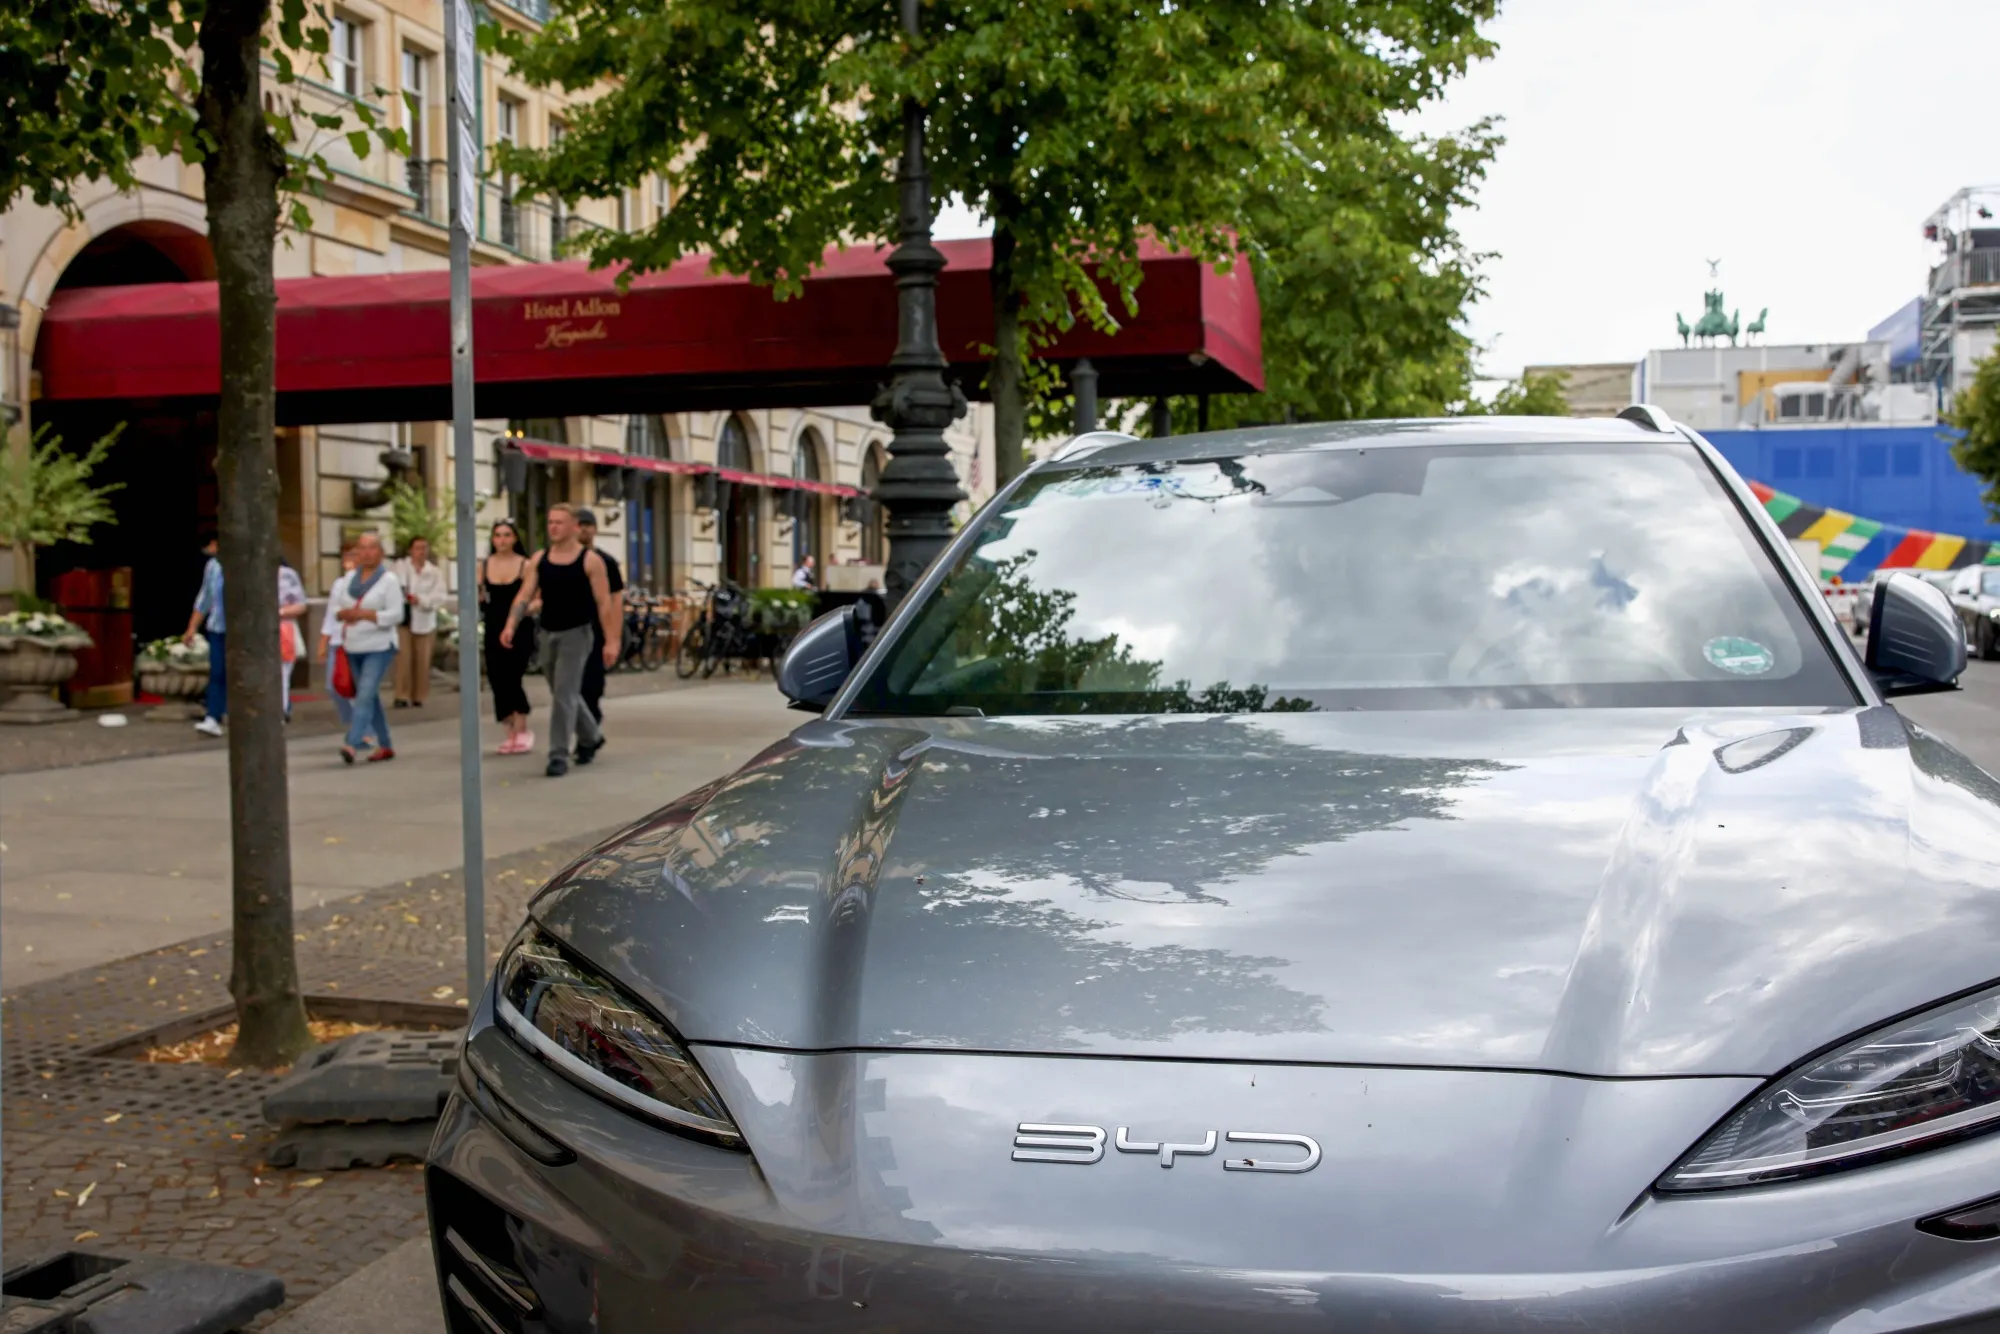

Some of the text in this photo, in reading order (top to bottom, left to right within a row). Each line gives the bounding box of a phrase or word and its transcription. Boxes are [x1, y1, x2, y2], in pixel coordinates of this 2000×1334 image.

[524, 298, 621, 320] Hotel Adlon
[1011, 1123, 1322, 1174] BYD
